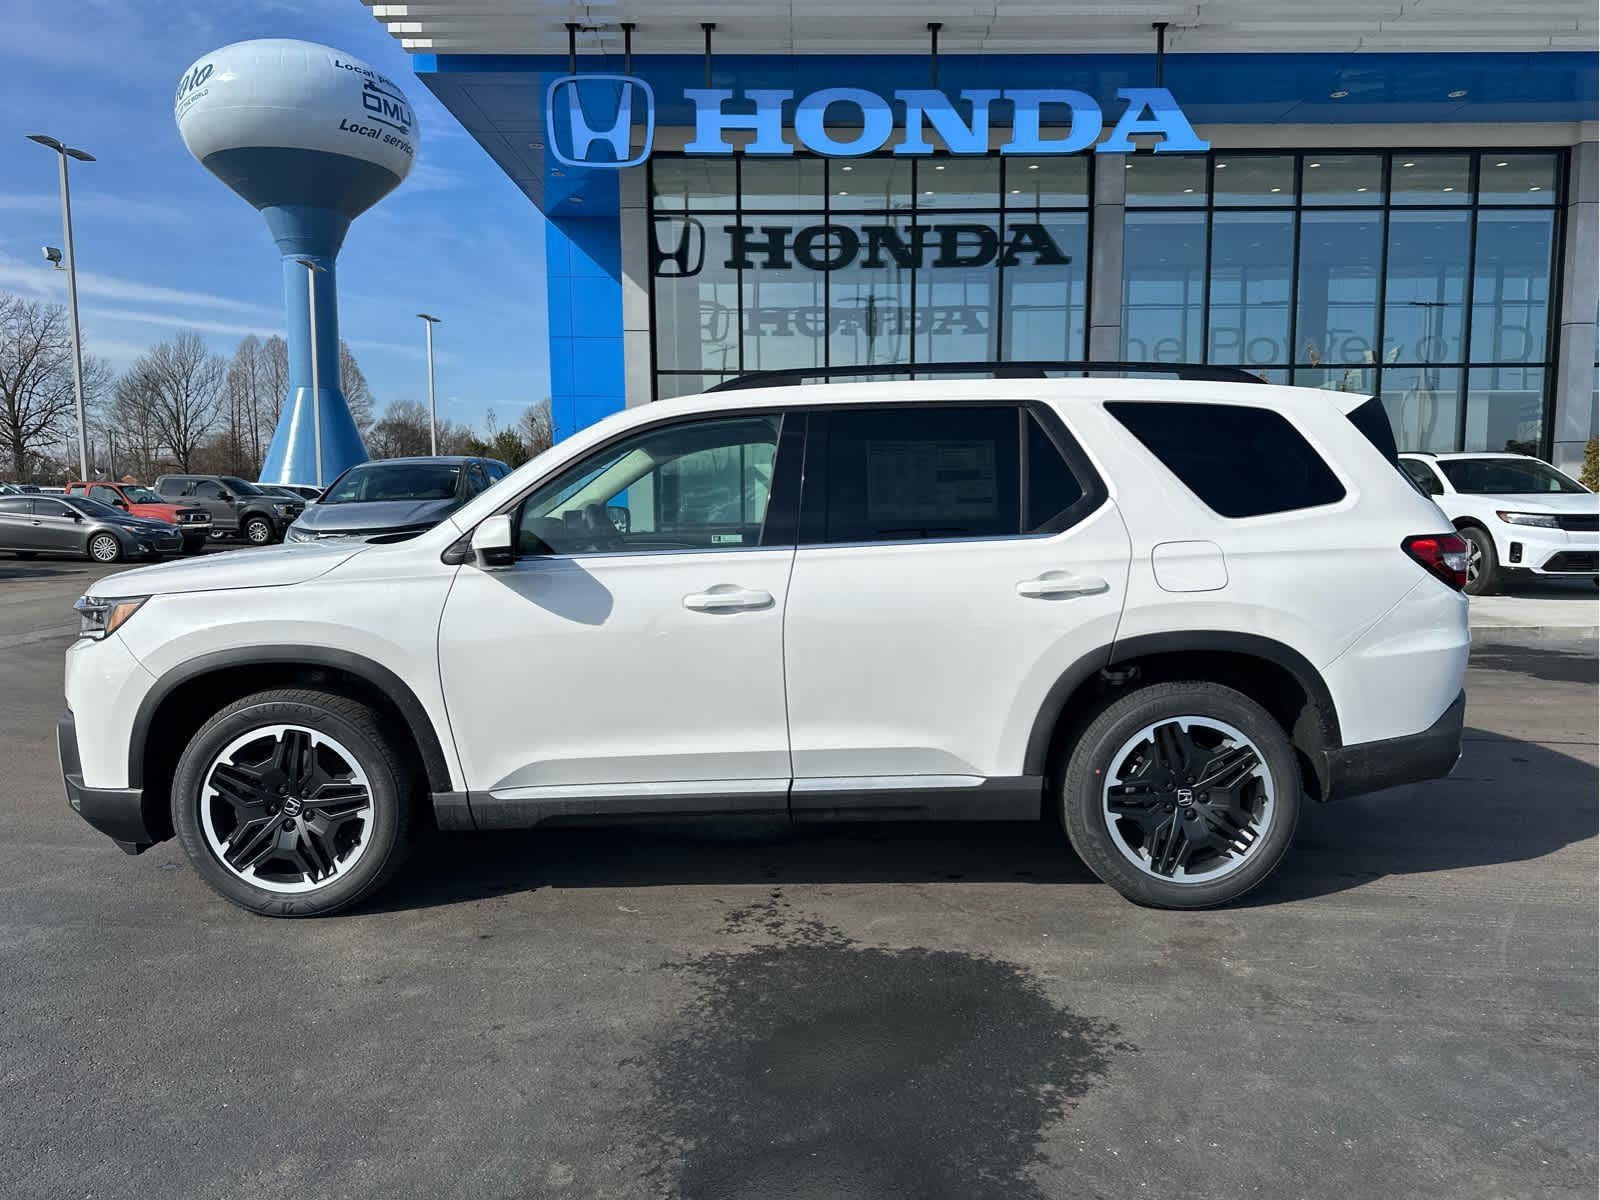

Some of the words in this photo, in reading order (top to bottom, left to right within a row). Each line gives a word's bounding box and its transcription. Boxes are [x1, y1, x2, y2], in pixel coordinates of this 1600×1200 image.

[335, 60, 375, 78] Local
[362, 91, 412, 127] OMU
[683, 87, 1210, 157] HONDA
[340, 118, 383, 140] Local
[383, 133, 415, 158] servic
[724, 224, 1071, 271] HONDA
